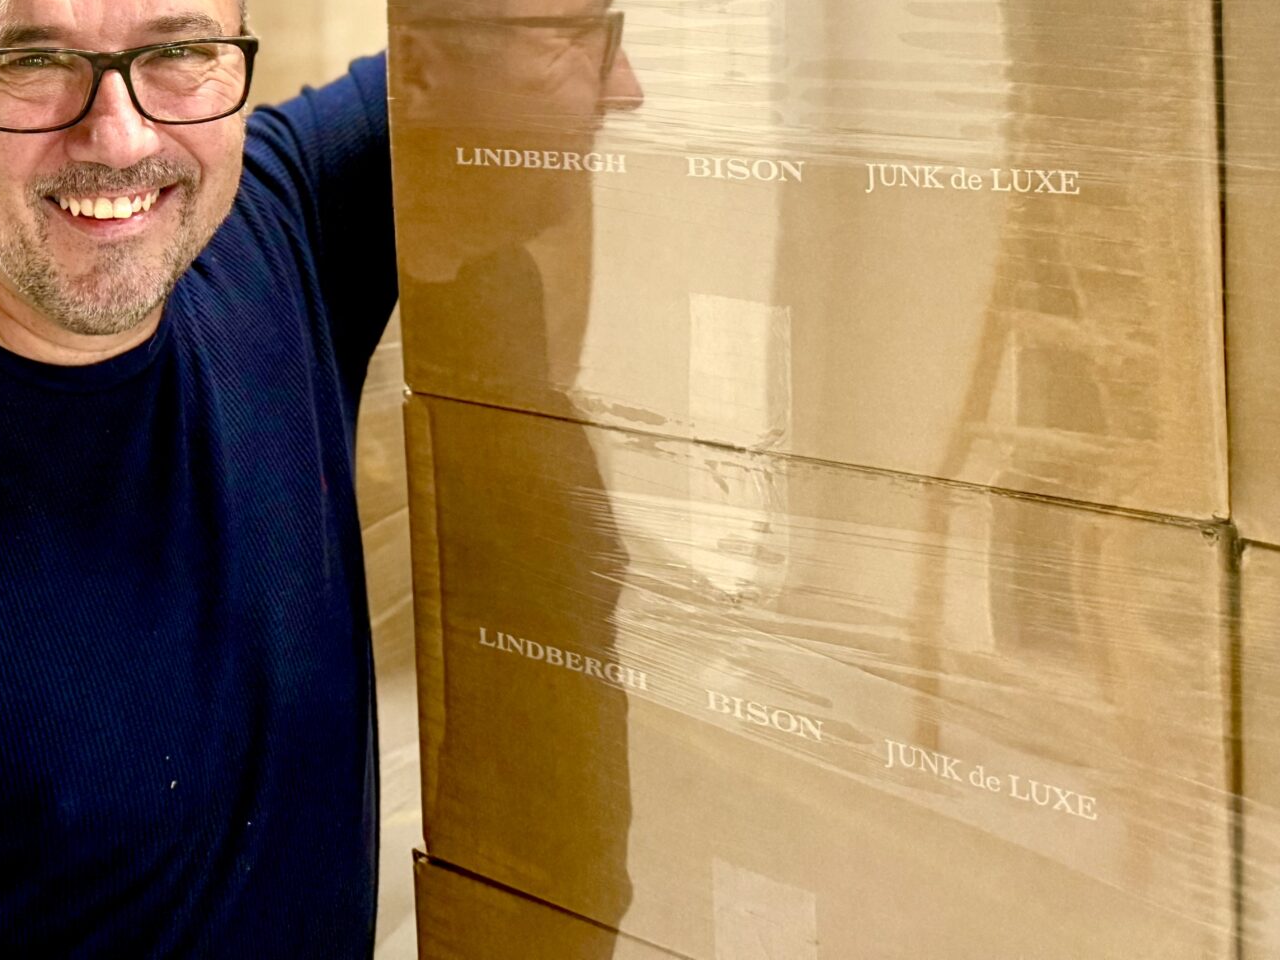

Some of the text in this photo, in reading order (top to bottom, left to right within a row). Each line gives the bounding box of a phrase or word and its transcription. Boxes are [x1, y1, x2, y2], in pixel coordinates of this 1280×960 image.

[455, 146, 1081, 196] LINDBERGH BISON JUNK de LUXE
[478, 626, 1098, 821] LINDBERGH BISON JUNK de LUXE
